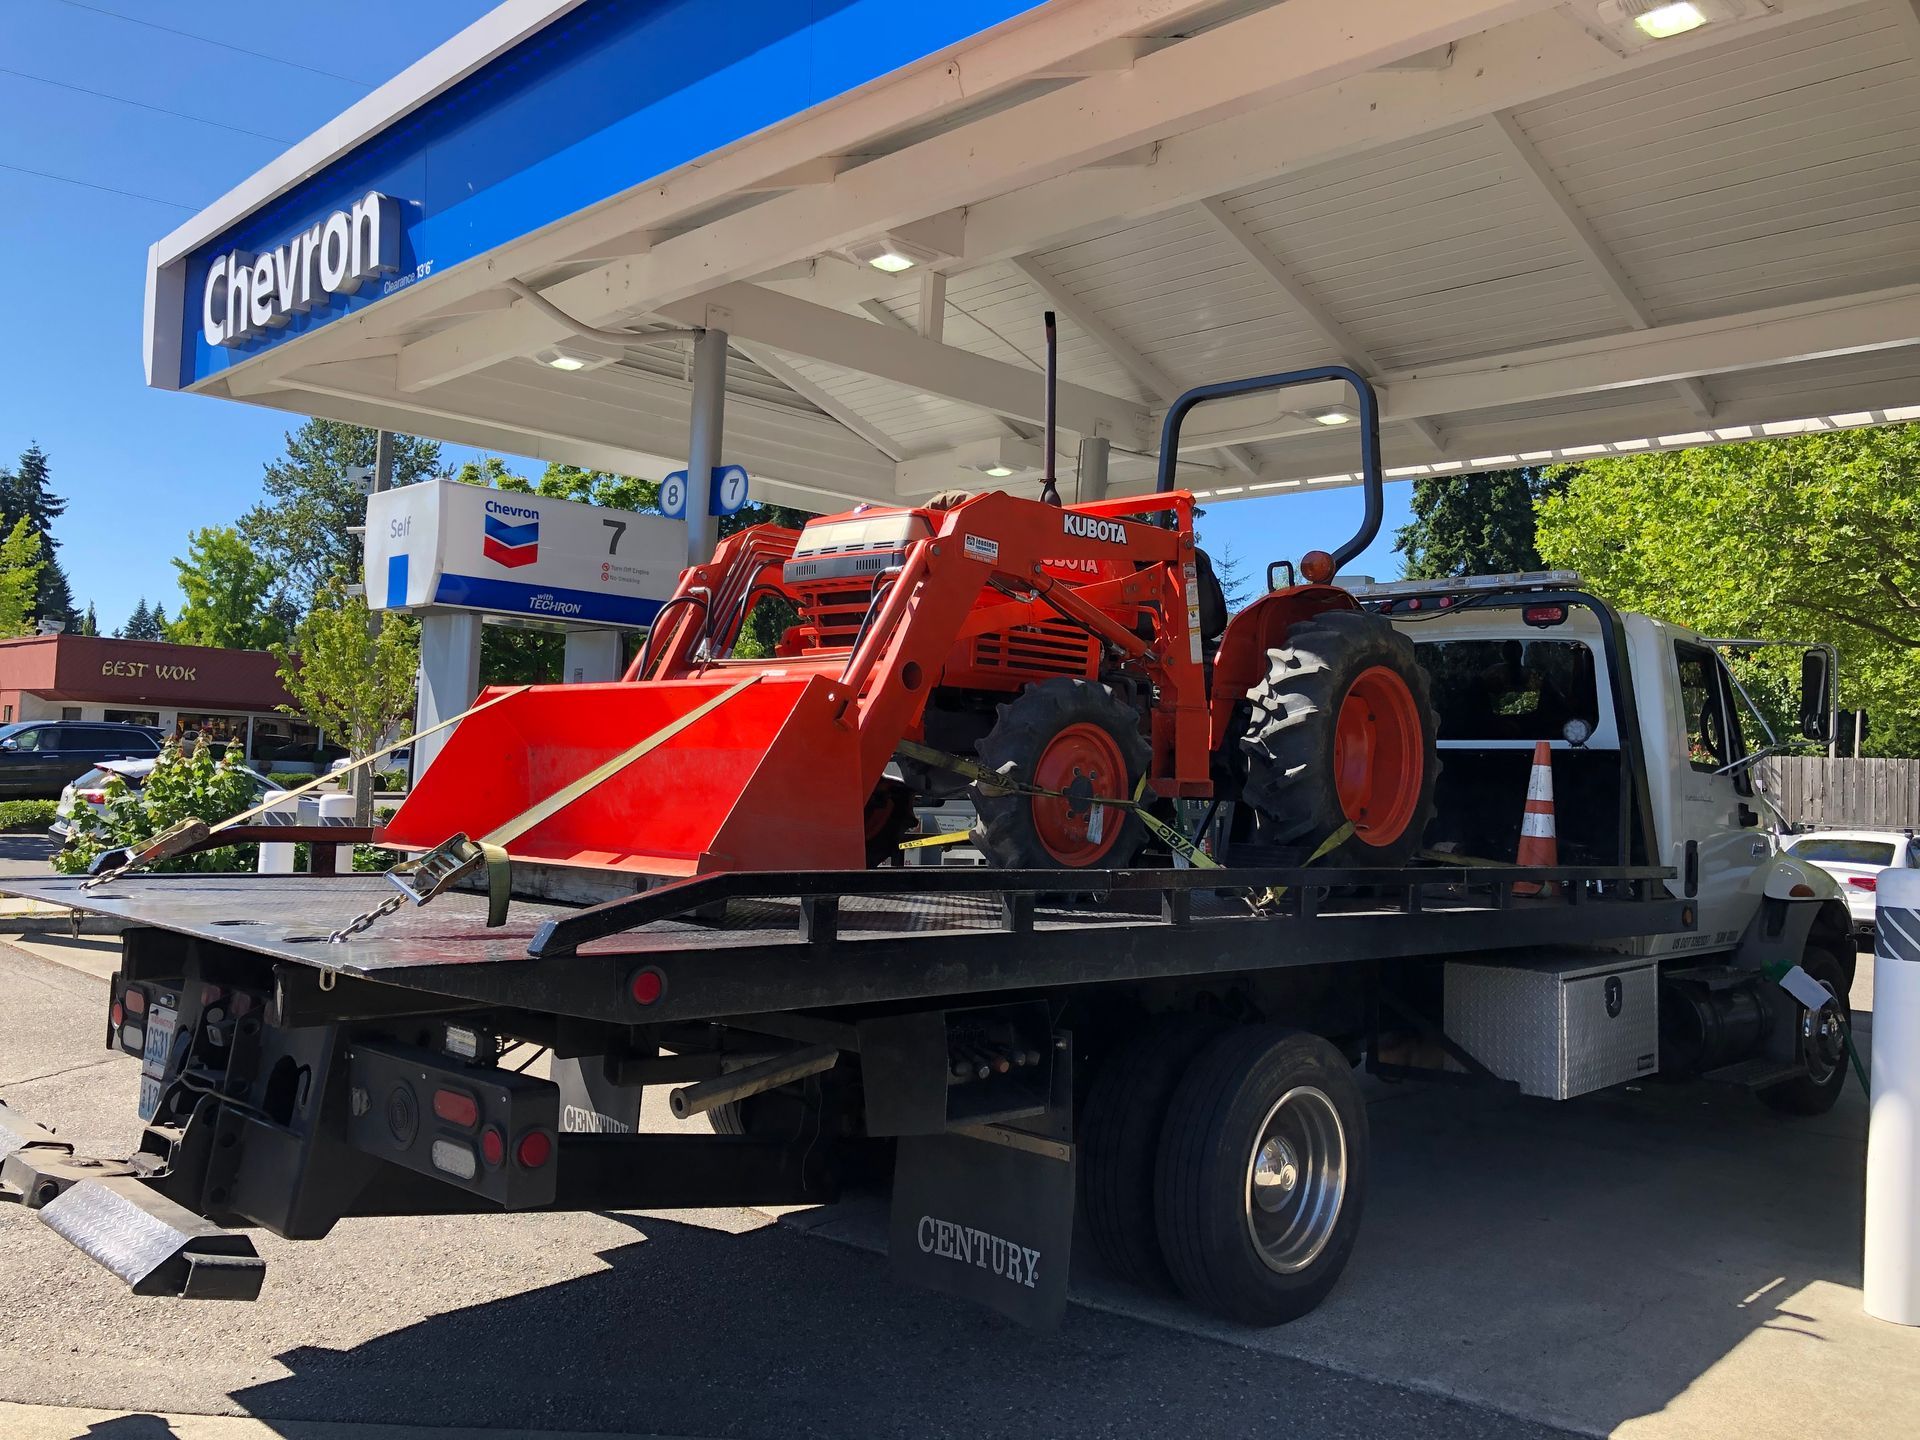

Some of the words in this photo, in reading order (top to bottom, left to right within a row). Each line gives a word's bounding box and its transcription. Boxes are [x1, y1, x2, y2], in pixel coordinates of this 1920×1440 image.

[203, 191, 390, 347] Chevron
[384, 273, 415, 294] Clearance
[667, 484, 679, 506] 8
[729, 478, 740, 500] 7
[485, 500, 539, 520] Chevron
[391, 516, 411, 538] Self
[603, 519, 626, 555] 7
[1063, 513, 1128, 545] KUBOTA
[529, 596, 582, 615] TECHRON
[537, 593, 554, 601] with
[102, 660, 149, 678] BEST
[155, 664, 196, 681] WOK
[918, 1215, 1040, 1288] CENTURY
